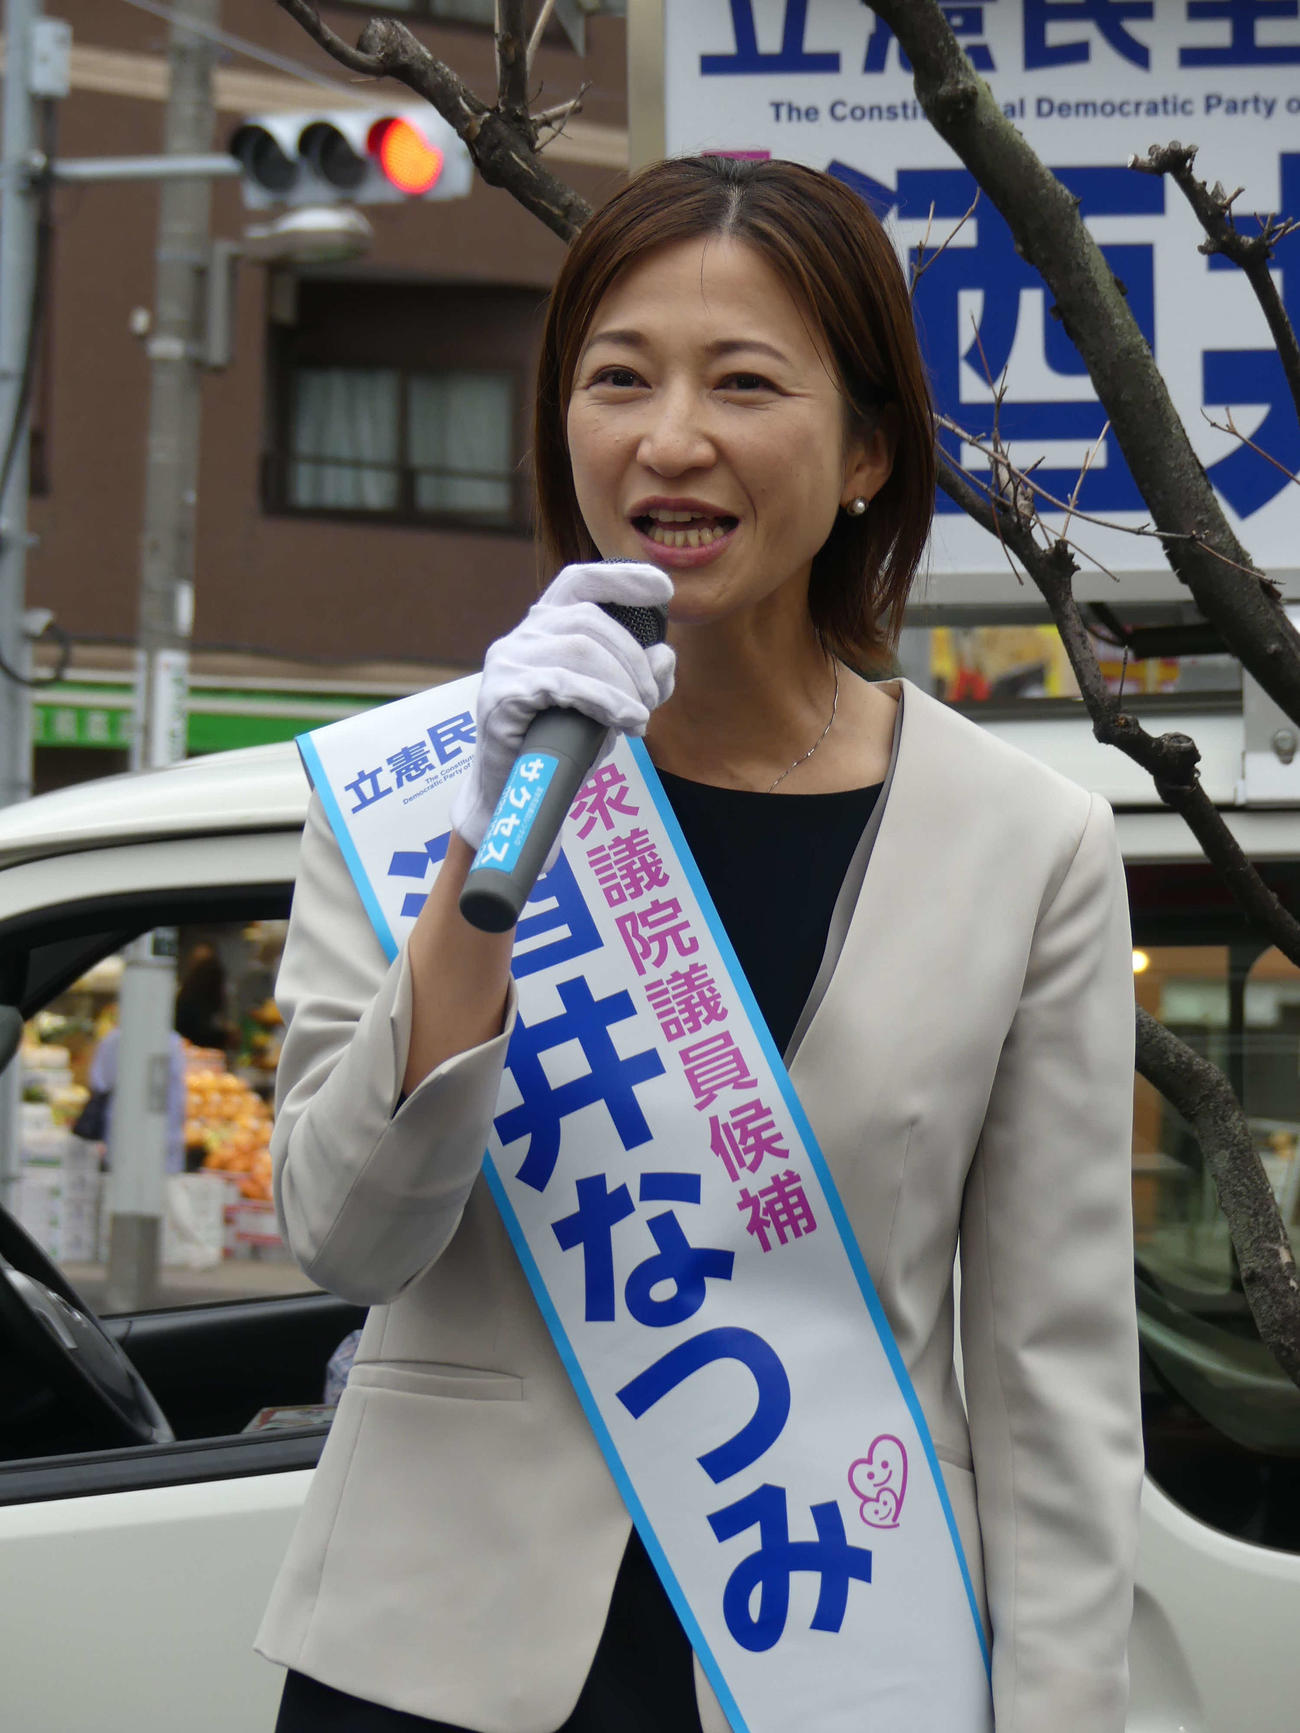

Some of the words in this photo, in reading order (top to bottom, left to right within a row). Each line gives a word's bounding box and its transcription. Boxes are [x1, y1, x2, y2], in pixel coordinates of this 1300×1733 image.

[770, 101, 819, 122] The
[830, 98, 1026, 121] Constial
[1036, 97, 1194, 118] Democratic
[1205, 93, 1276, 118] Party
[402, 779, 444, 805] Democratic
[481, 758, 545, 865] サクセス
